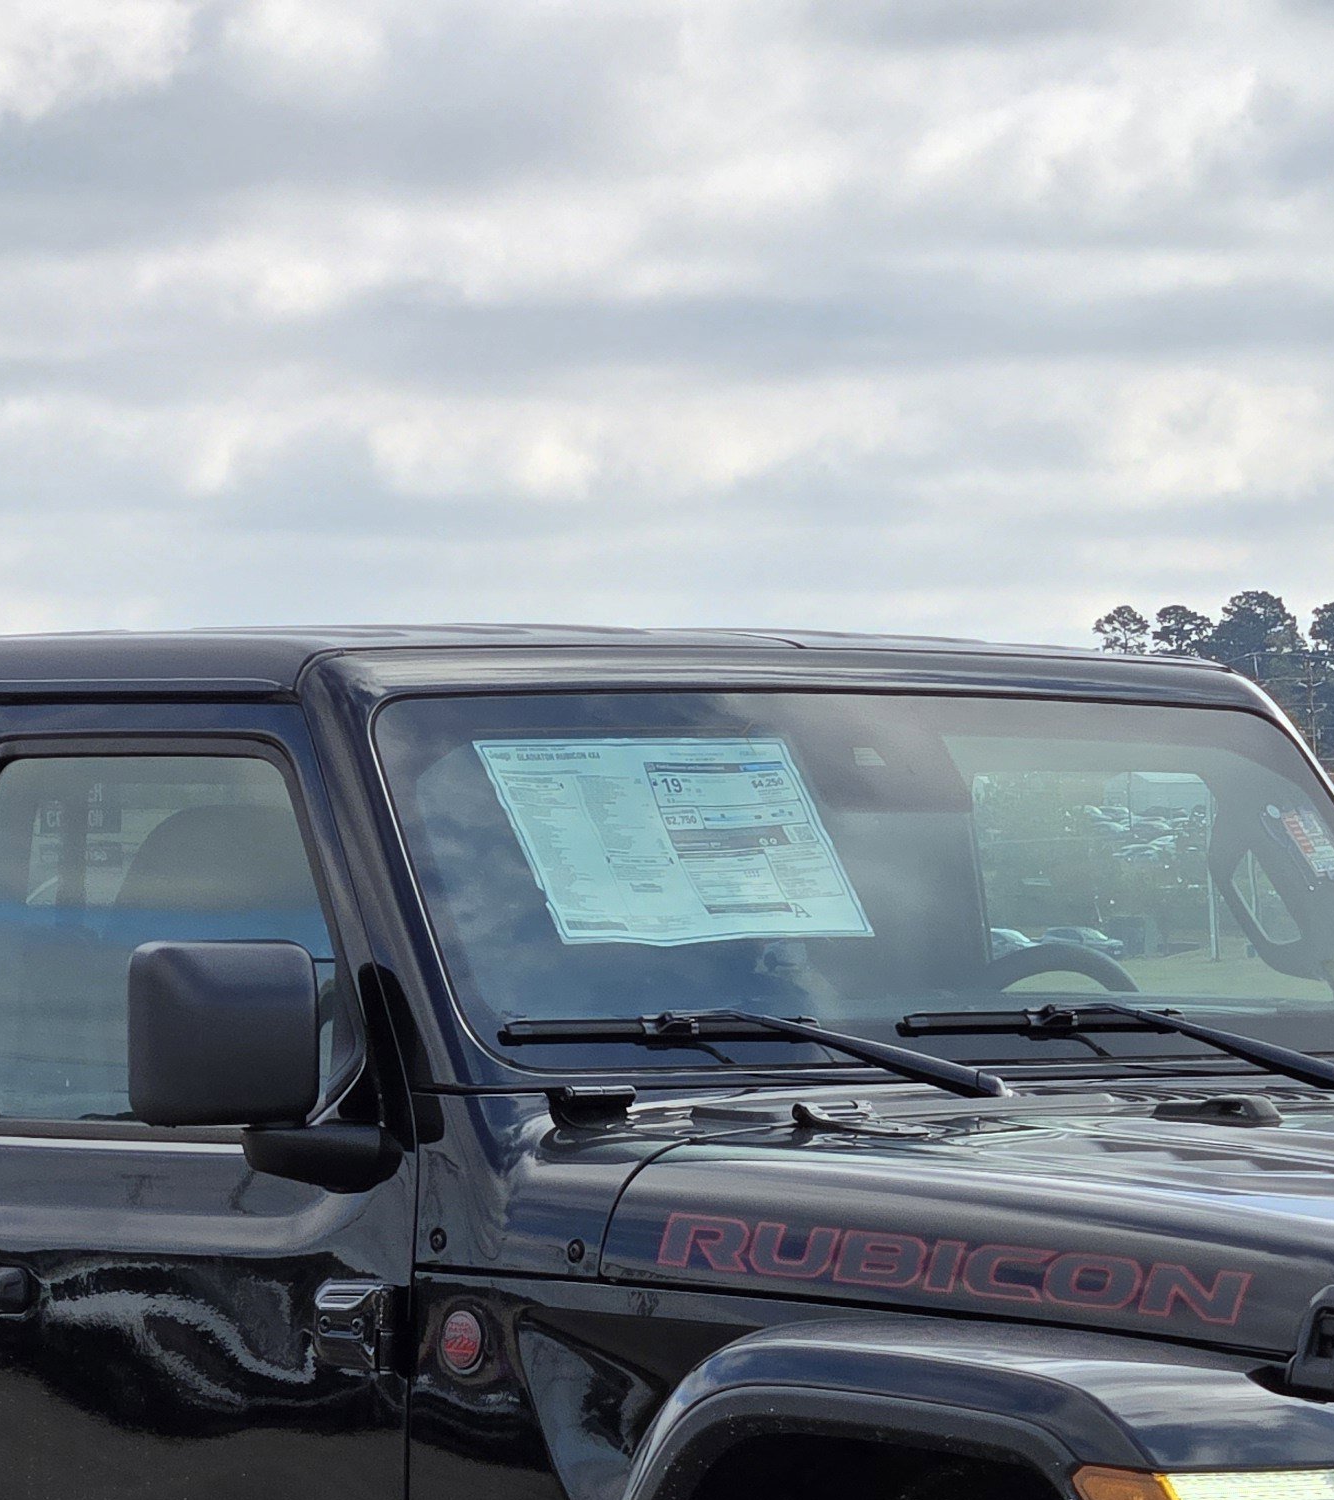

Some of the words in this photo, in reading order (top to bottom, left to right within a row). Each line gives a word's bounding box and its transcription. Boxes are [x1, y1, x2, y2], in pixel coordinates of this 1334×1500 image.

[661, 777, 683, 794] 19
[751, 776, 784, 789] $4,250
[665, 814, 697, 826] $2,750
[657, 1211, 1253, 1325] RUBICON
